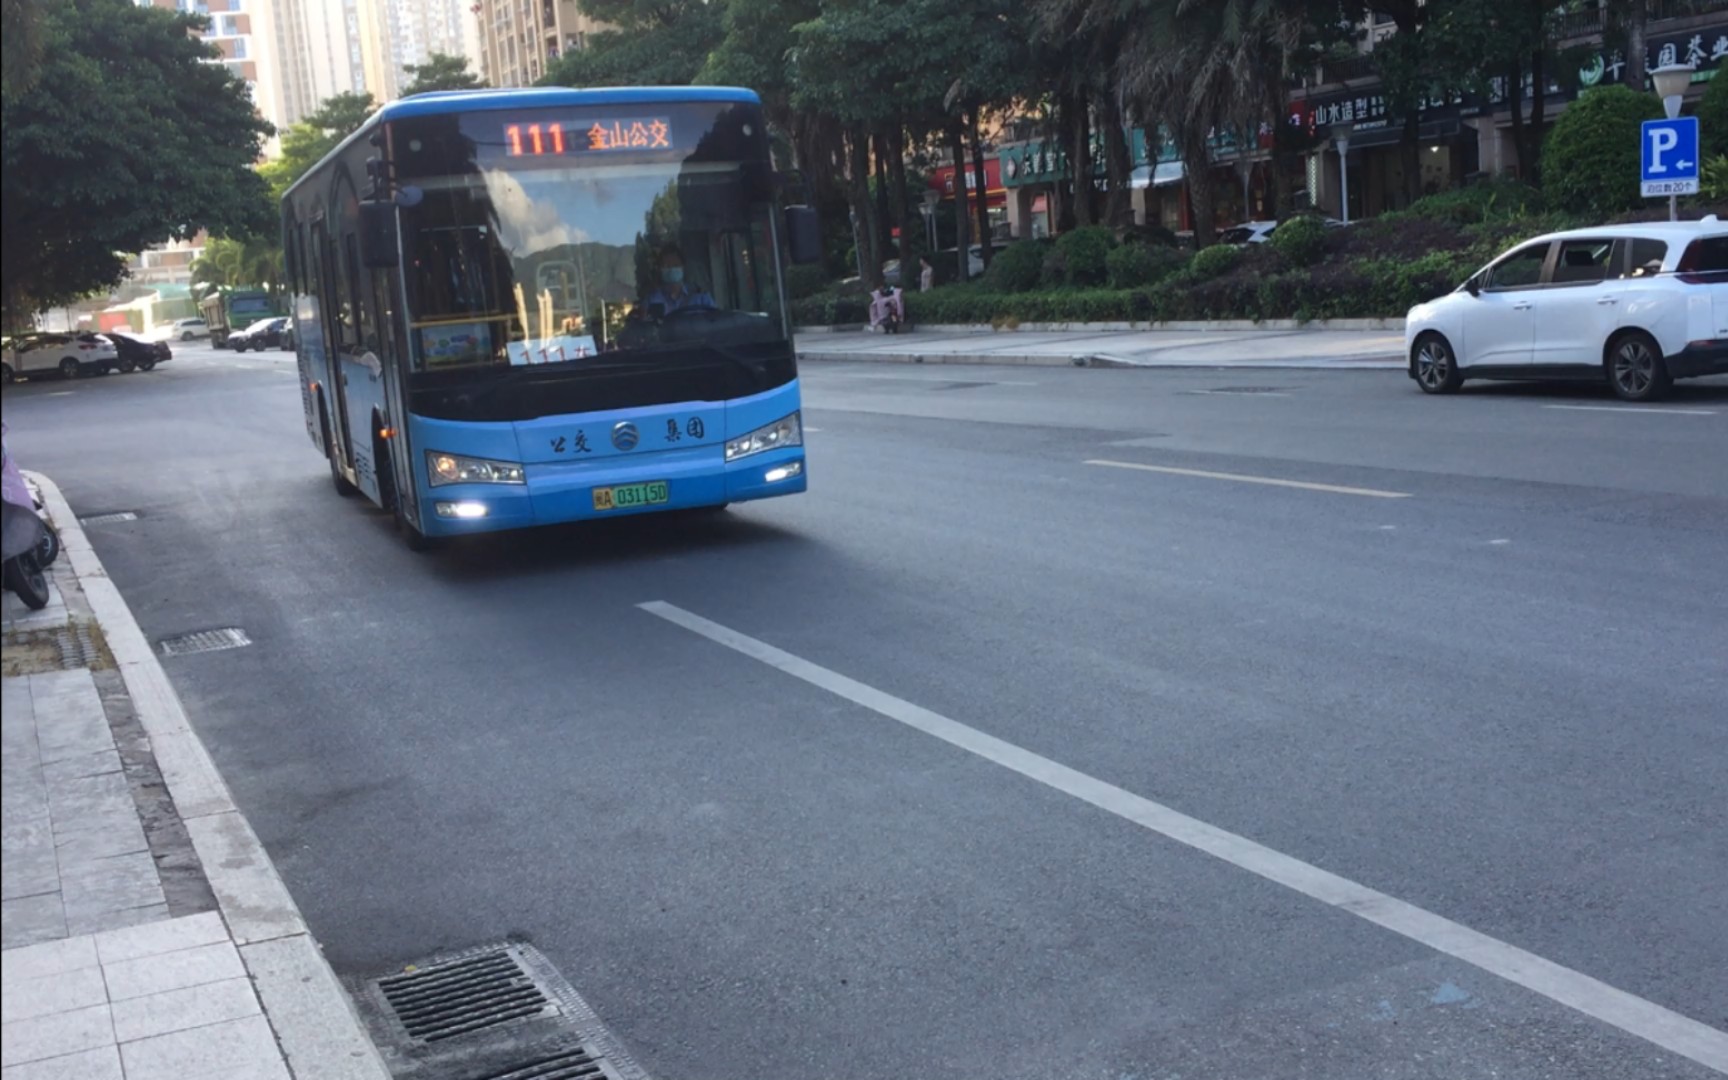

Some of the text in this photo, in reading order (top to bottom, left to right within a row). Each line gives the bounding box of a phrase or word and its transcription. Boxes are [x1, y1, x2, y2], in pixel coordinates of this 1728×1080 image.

[1316, 98, 1368, 125] 山水造型
[507, 123, 564, 156] 111
[587, 119, 669, 150] 金山公交
[1648, 127, 1678, 173] P
[550, 429, 591, 453] 公交
[664, 416, 704, 442] 集团
